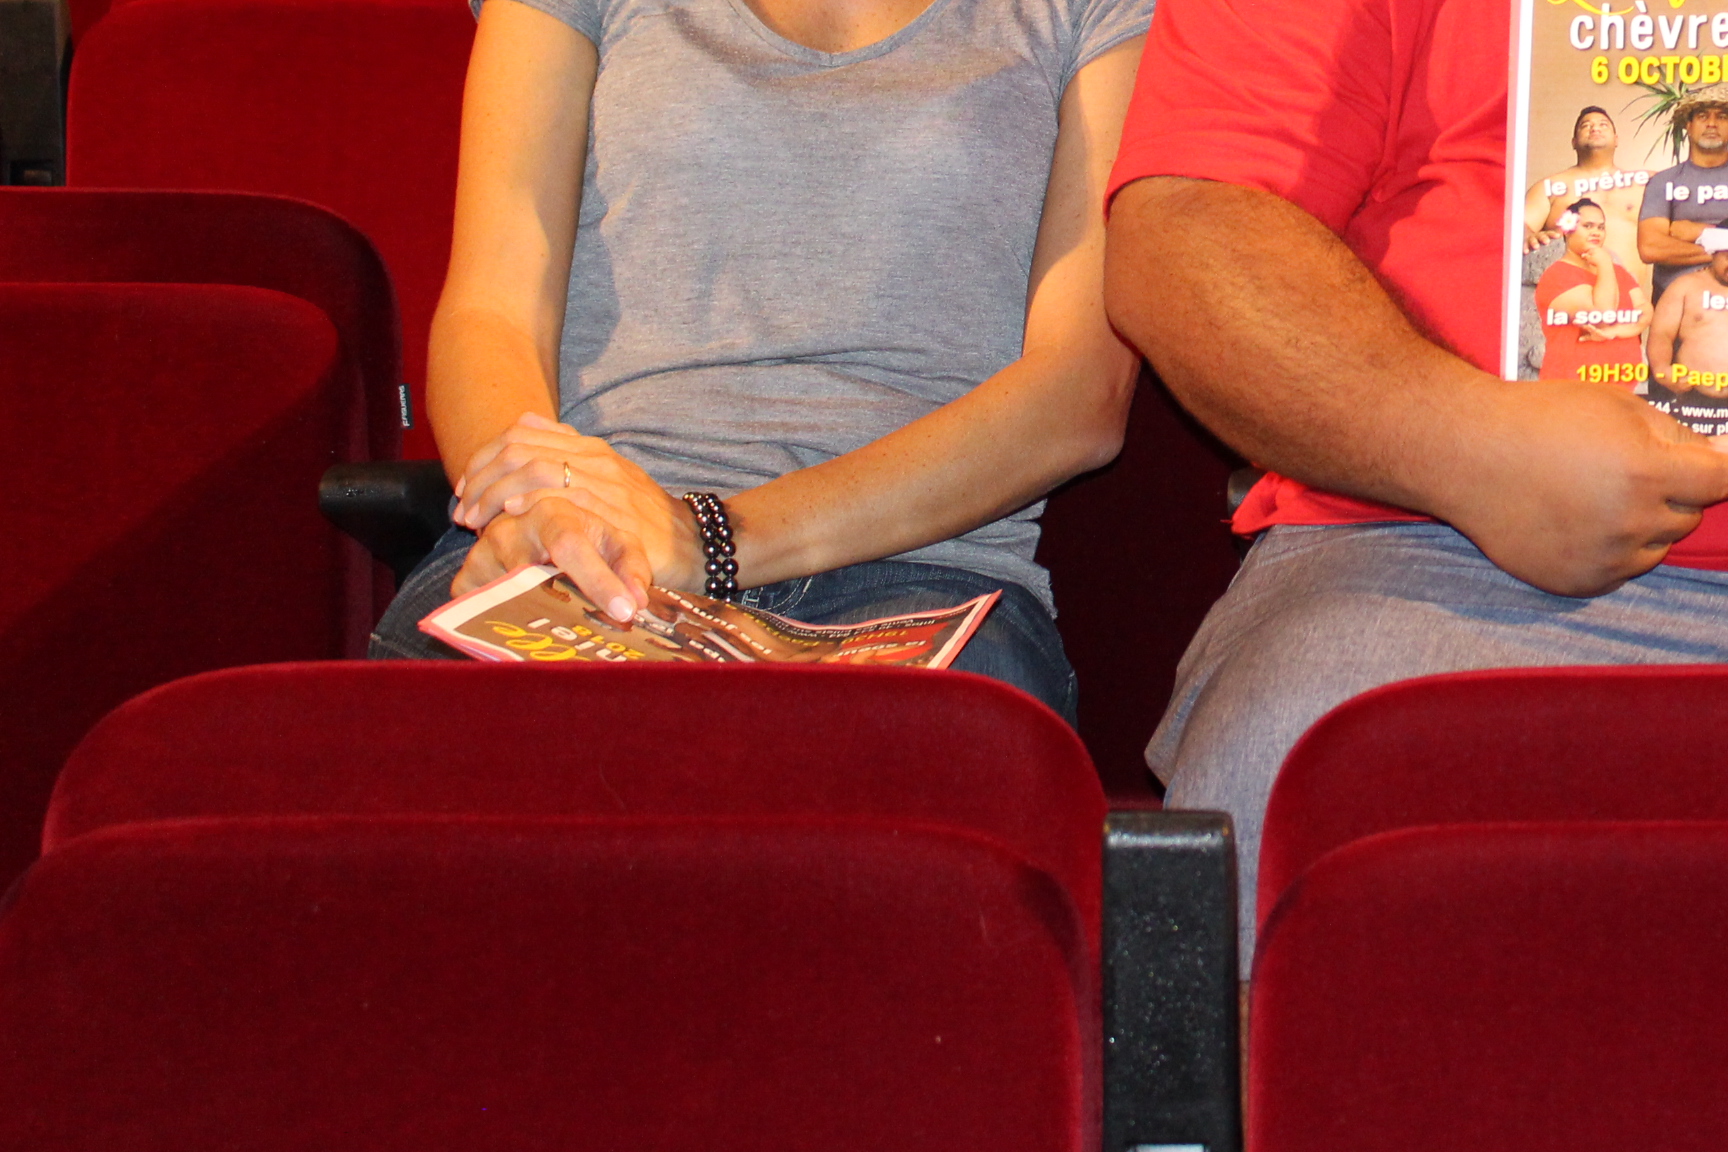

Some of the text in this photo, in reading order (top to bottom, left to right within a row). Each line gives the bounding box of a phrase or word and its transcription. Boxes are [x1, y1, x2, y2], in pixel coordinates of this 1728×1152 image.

[1591, 56, 1610, 85] 6
[1544, 168, 1650, 198] le prêtre
[1665, 182, 1689, 201] le
[1546, 307, 1643, 326] la soeur
[1576, 362, 1648, 384] 19H30
[1692, 423, 1713, 434] sur
